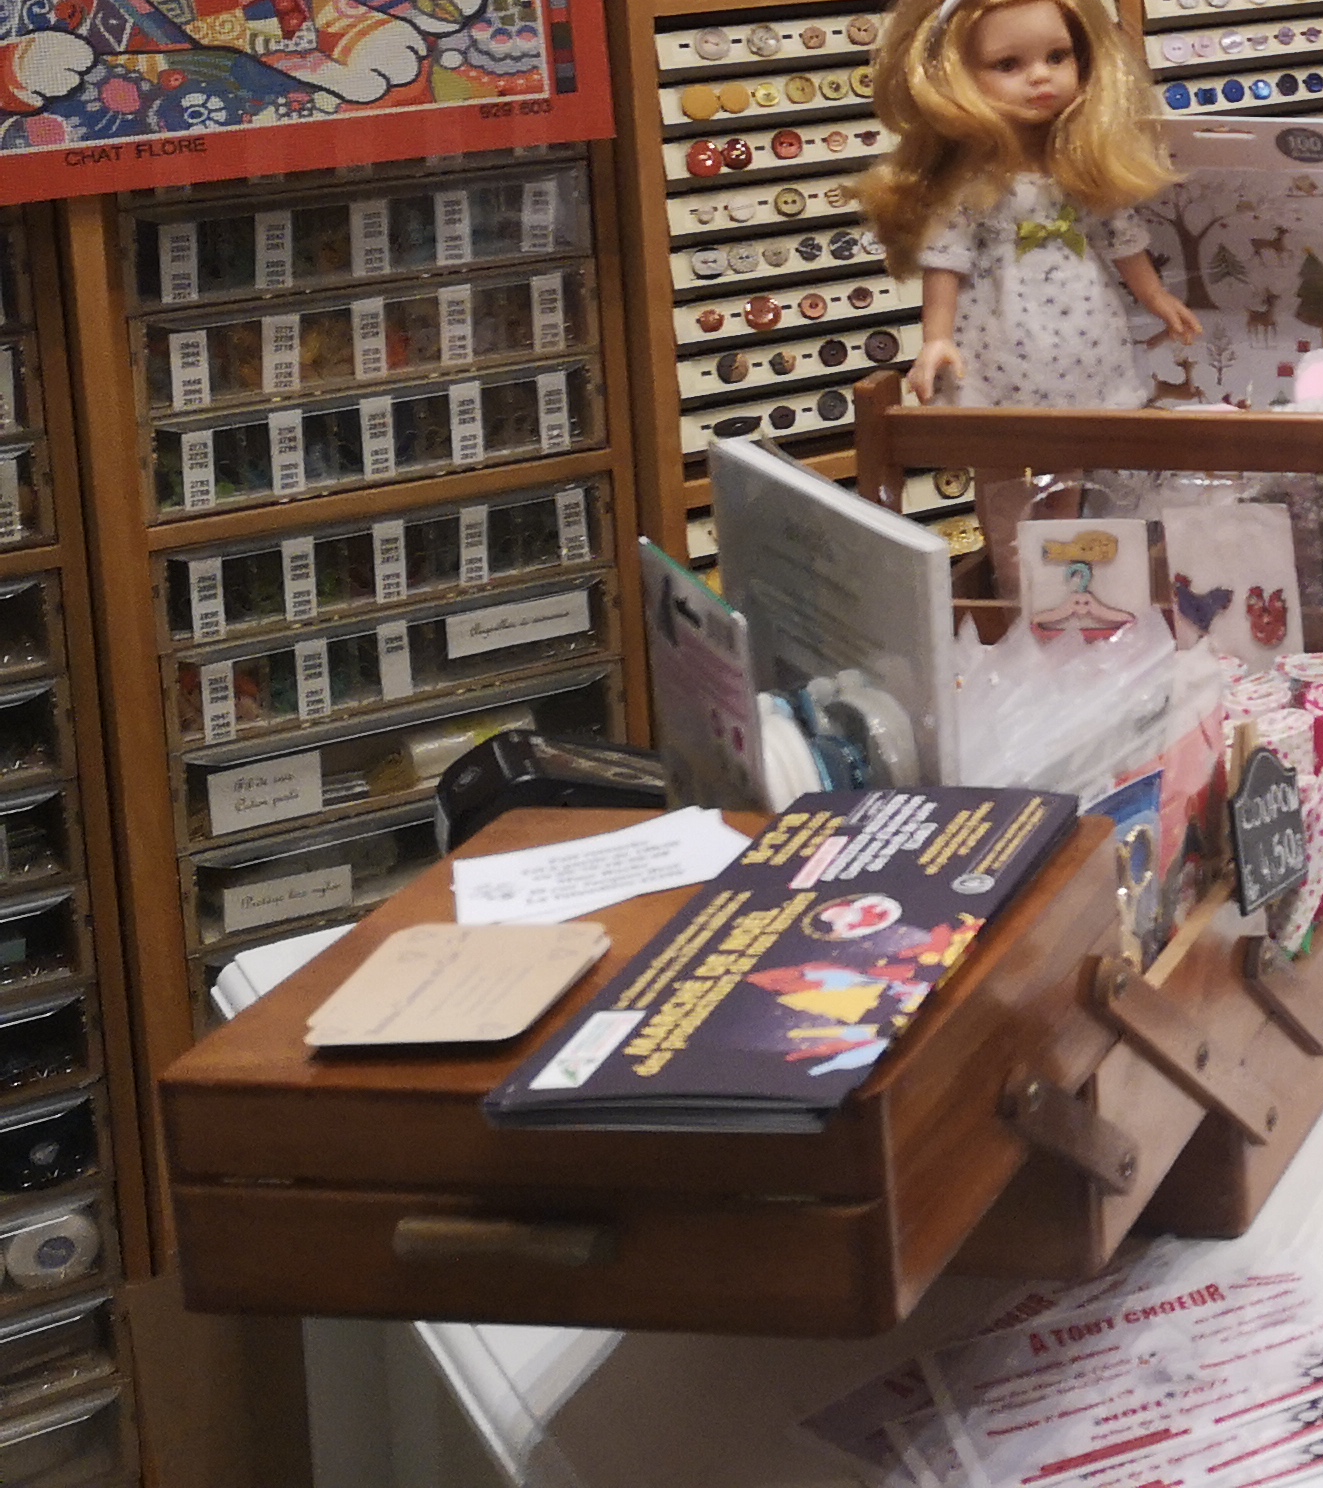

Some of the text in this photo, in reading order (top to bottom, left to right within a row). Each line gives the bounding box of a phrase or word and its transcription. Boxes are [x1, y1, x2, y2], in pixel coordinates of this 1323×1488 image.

[64, 136, 208, 168] CHAT FLORE
[1050, 1315, 1116, 1348] TOUT
[1122, 1282, 1227, 1325] CHOEUR
